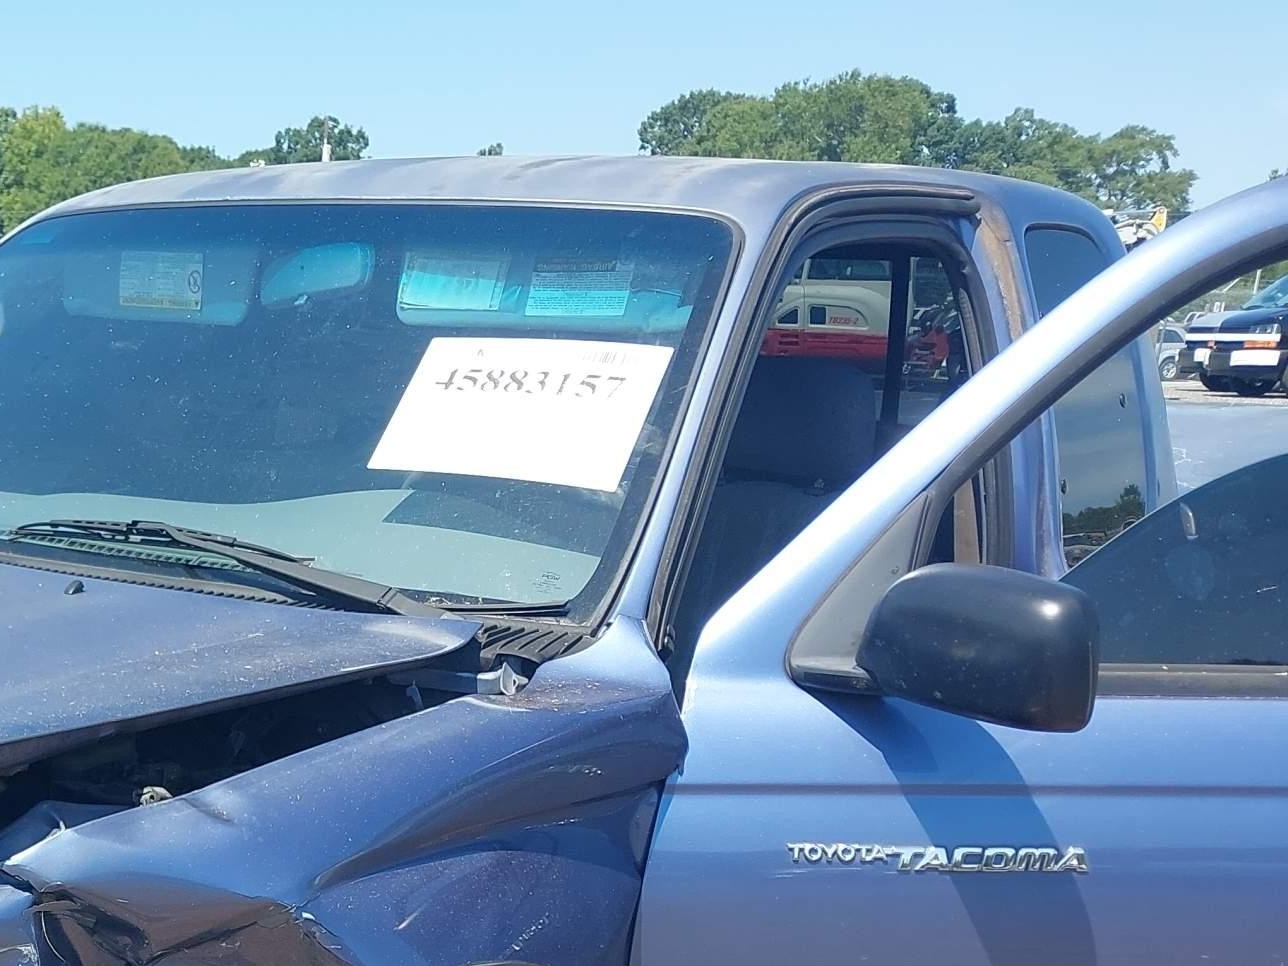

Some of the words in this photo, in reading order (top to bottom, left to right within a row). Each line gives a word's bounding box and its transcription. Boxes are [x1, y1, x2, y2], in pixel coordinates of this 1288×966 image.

[435, 368, 627, 399] 45883157
[786, 842, 889, 865] TOYOTA
[889, 844, 1089, 873] TACOMA
